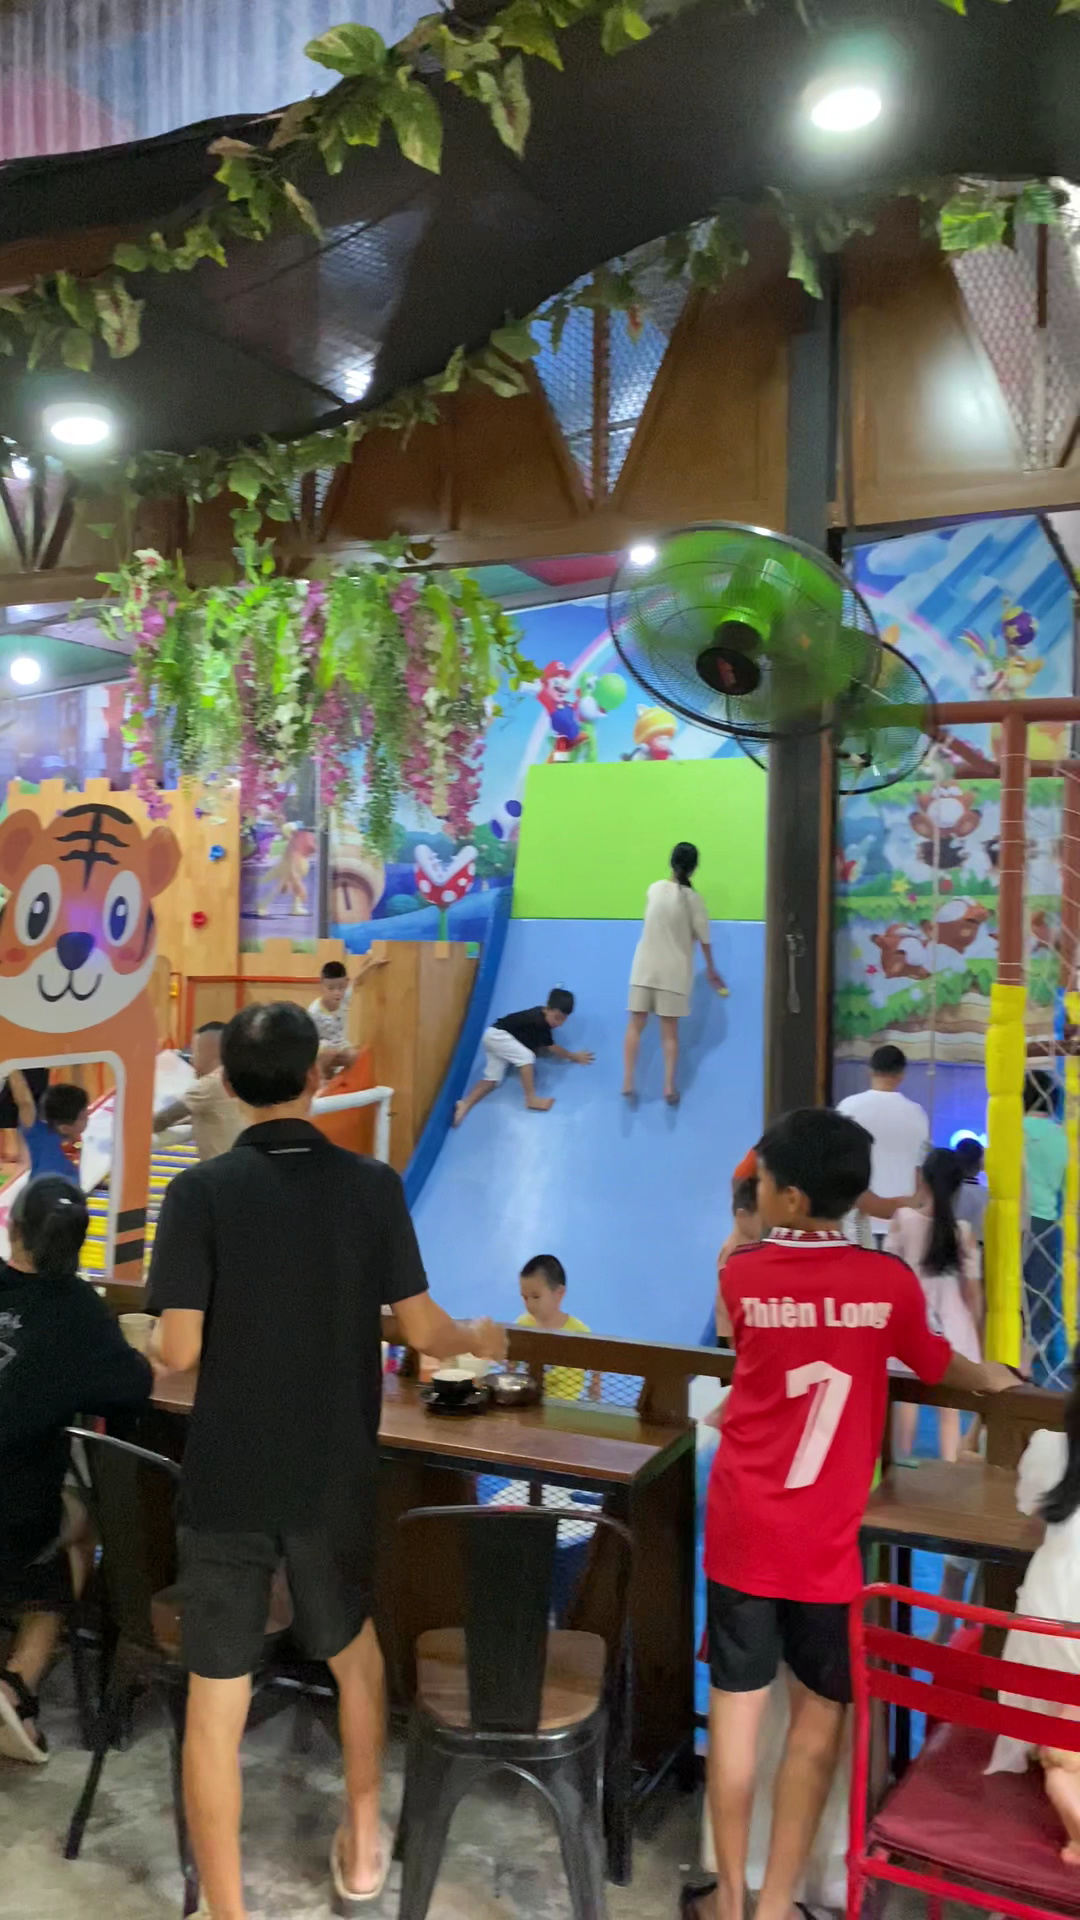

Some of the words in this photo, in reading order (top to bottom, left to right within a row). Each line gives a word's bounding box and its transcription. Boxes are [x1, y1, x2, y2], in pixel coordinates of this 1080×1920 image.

[740, 1297, 817, 1328] Thiên
[823, 1297, 893, 1329] Long
[784, 1361, 852, 1489] 7
